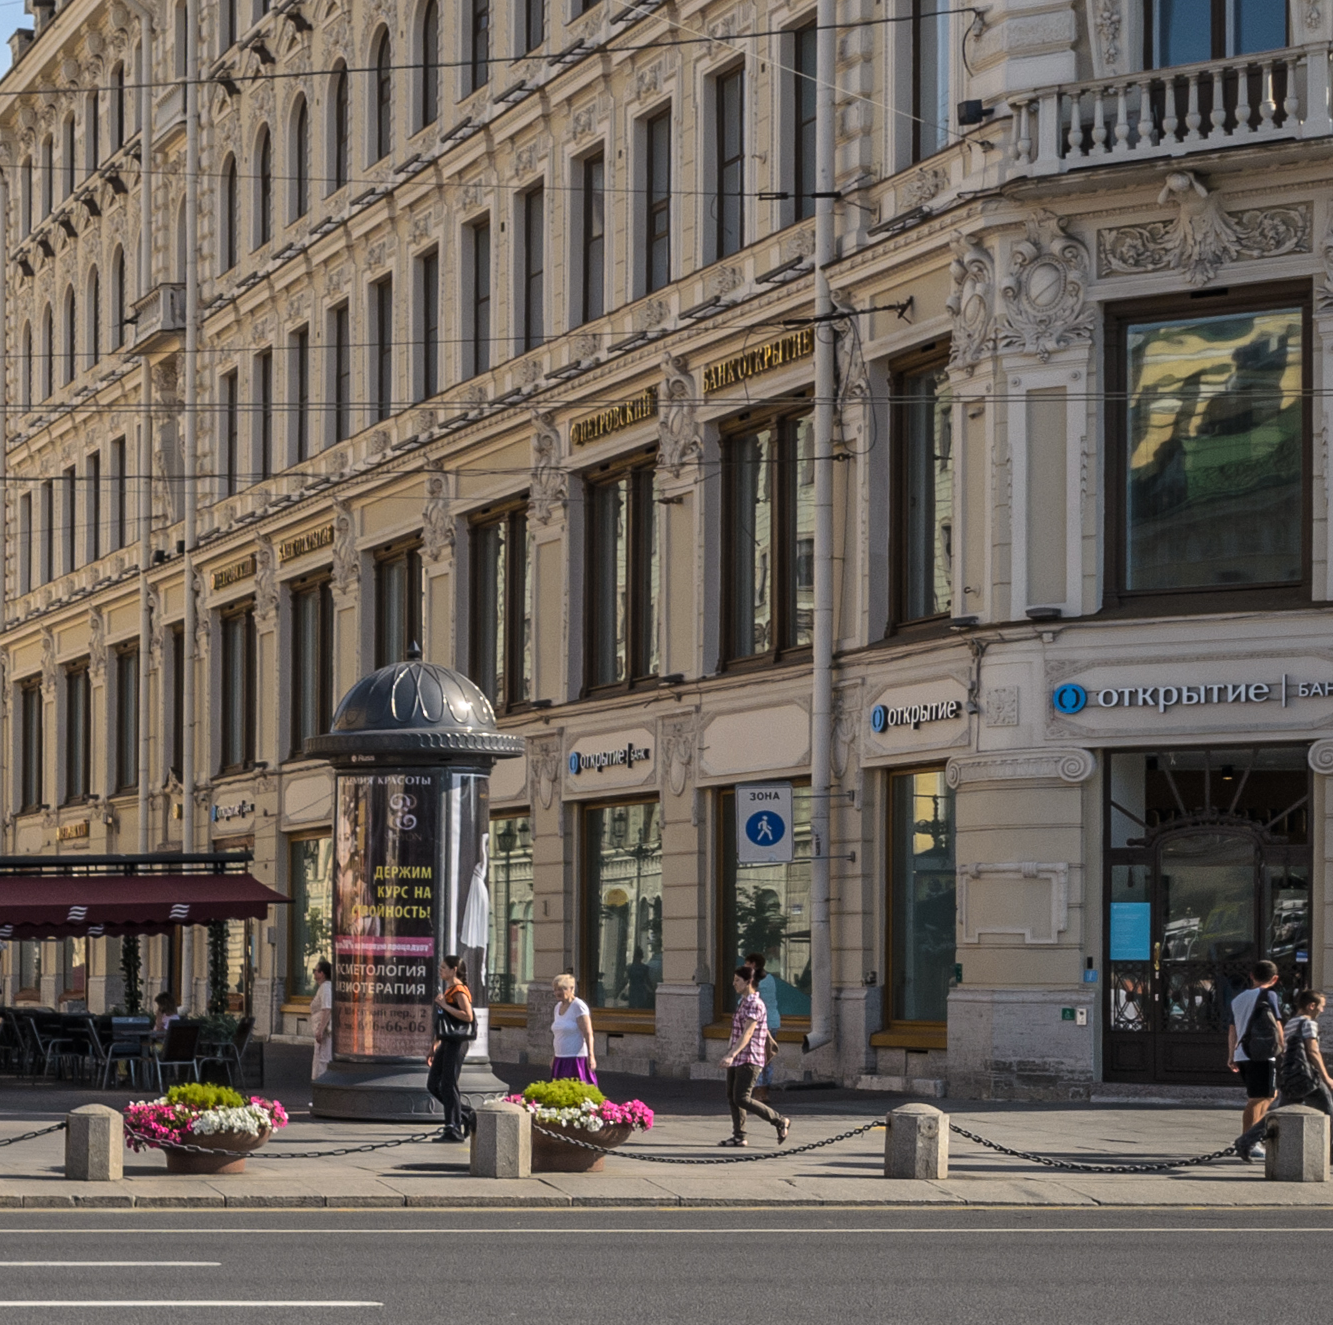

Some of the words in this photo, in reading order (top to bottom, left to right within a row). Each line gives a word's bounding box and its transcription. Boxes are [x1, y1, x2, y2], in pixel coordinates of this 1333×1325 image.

[581, 387, 655, 442] ПЕТРОВСКИЙ
[703, 364, 735, 394] БАНК
[736, 328, 814, 380] ОТКРЫТИЕ
[1097, 682, 1270, 713] открытие
[887, 699, 949, 729] открытие
[579, 749, 625, 772] открытие
[377, 777, 431, 785] КРАСОТЫ
[749, 791, 780, 801] ЗОНА
[374, 866, 432, 879] ДЕРЖИМ
[377, 886, 408, 899] КУРС
[414, 886, 432, 899] НА
